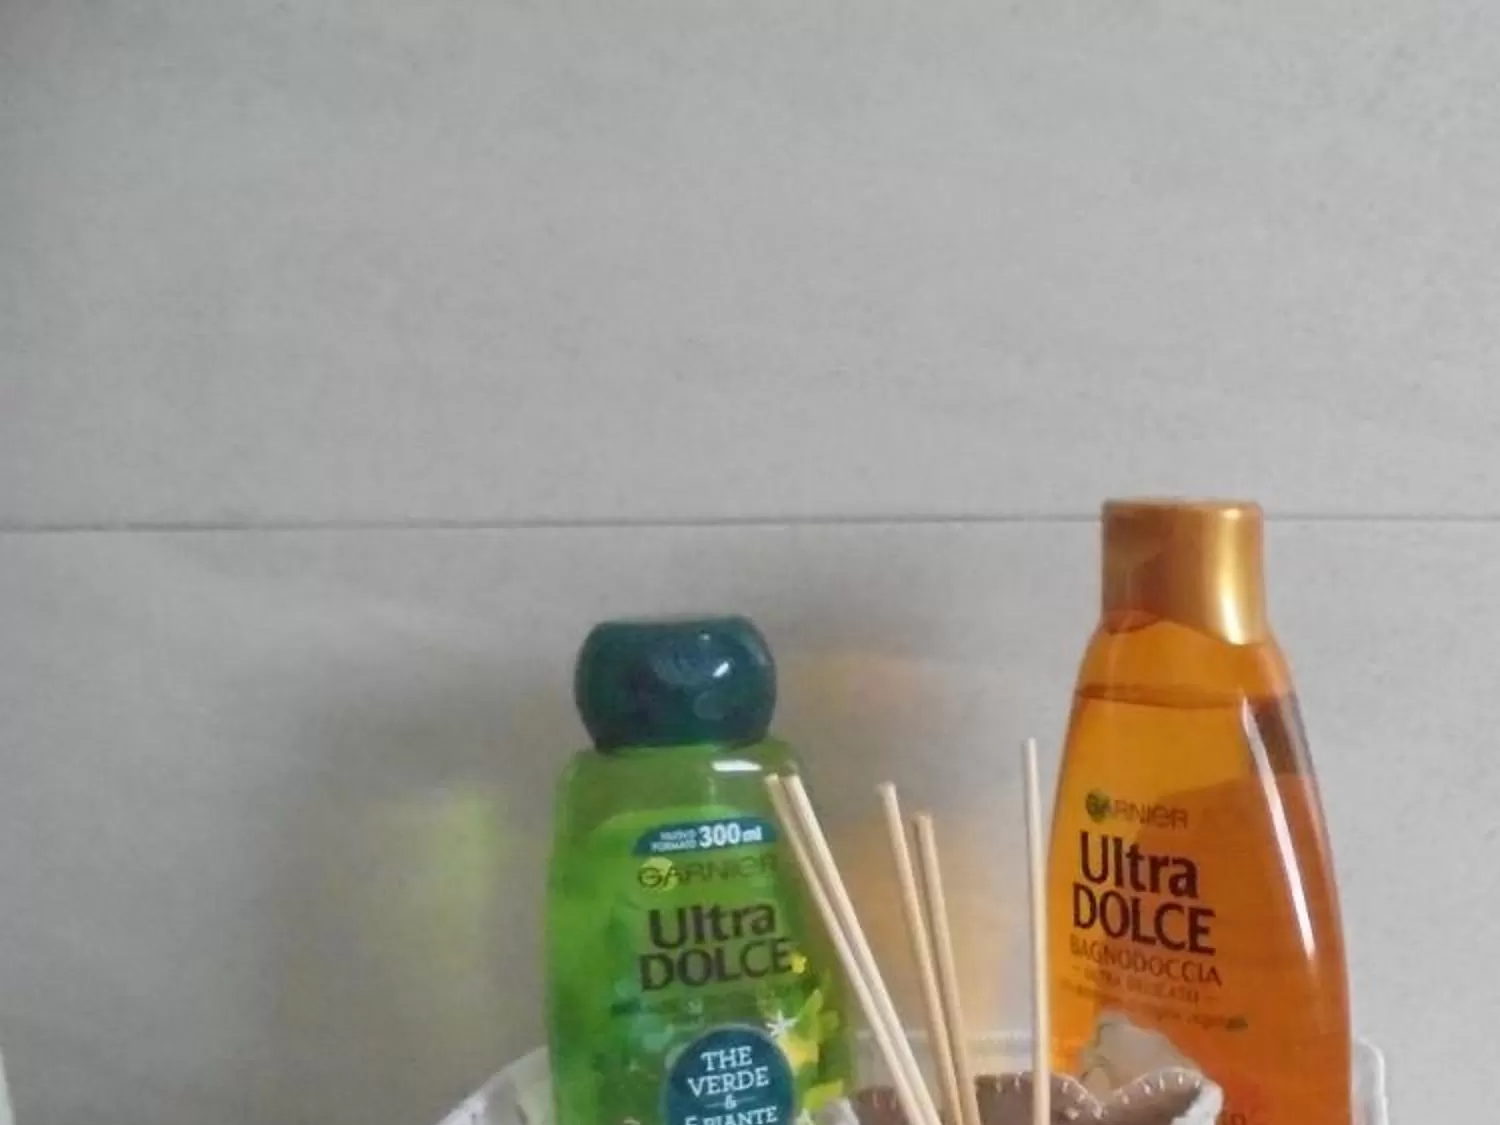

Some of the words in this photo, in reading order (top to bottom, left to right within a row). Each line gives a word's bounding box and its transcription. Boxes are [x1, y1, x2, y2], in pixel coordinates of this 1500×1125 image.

[698, 822, 762, 849] 300ml
[637, 853, 777, 888] GARNIER
[1079, 830, 1198, 898] Ultra
[649, 904, 775, 949] Ultra
[1073, 882, 1217, 956] DOLCE
[640, 937, 792, 992] DOLCE
[1069, 933, 1222, 987] BAGNODOCCIA
[687, 1065, 770, 1097] VERDE
[700, 1045, 753, 1072] THE
